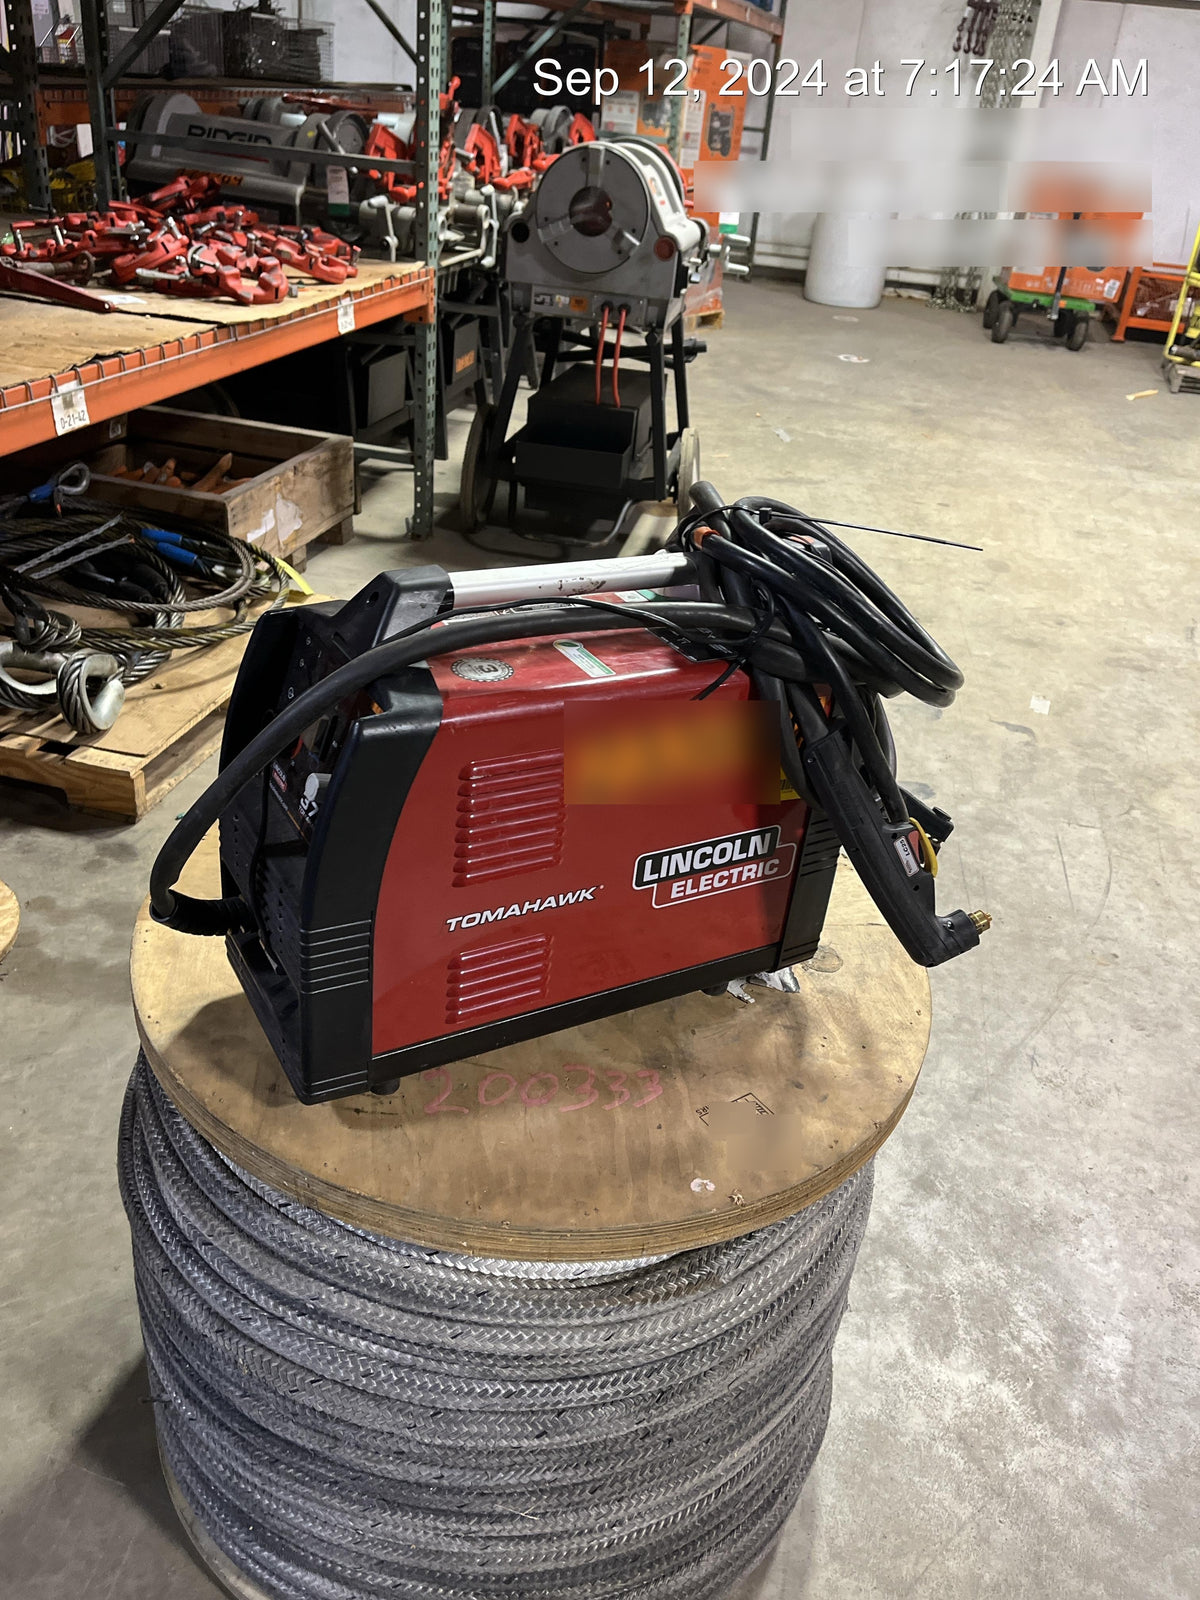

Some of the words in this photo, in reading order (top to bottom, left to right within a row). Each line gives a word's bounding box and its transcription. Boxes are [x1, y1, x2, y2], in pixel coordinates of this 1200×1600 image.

[643, 832, 772, 883] LINCOLN
[669, 858, 780, 899] ELECTRIC
[446, 886, 598, 932] TOMAHAWK
[422, 1063, 664, 1115] 200333
